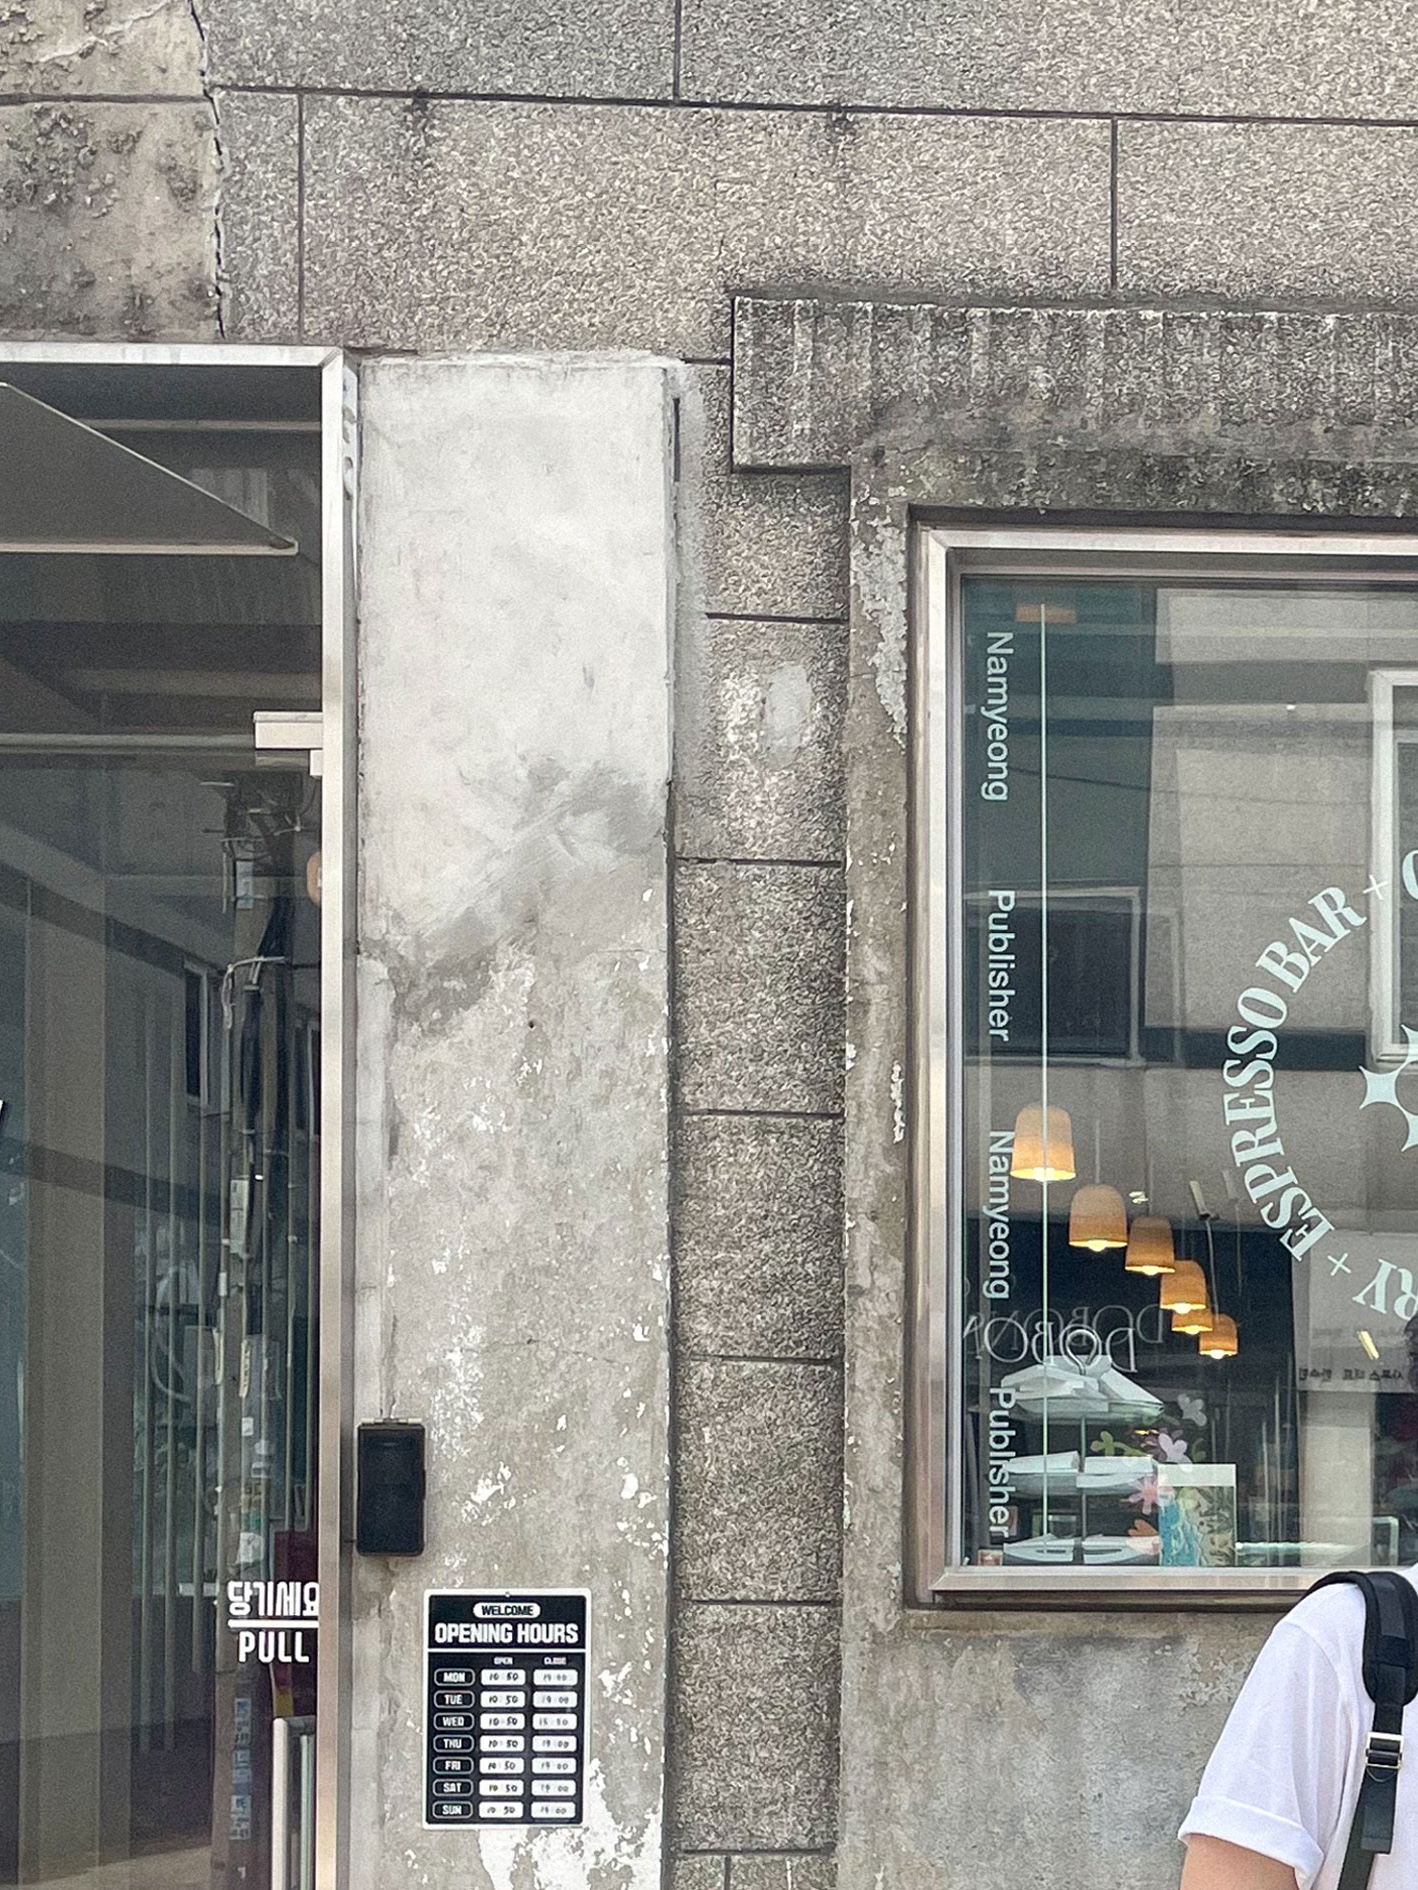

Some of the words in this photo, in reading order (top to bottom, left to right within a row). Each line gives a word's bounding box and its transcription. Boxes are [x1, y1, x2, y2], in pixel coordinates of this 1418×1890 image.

[980, 631, 1014, 801] Namyeong
[1254, 885, 1368, 993] BAR
[988, 890, 1016, 1042] Publisher
[1221, 986, 1335, 1262] ESPRESSO
[982, 1130, 1016, 1300] Namyeong
[989, 1387, 1016, 1539] Publisher
[227, 1581, 319, 1616] 당기세요
[481, 1605, 534, 1616] WELCOME
[434, 1622, 513, 1644] OPENING
[517, 1622, 579, 1644] HOURS
[239, 1631, 309, 1663] PULL
[443, 1672, 466, 1683] MON
[444, 1694, 463, 1705] TUE
[442, 1716, 465, 1726] WED
[443, 1738, 462, 1749] THU
[445, 1760, 461, 1770] FRI
[443, 1783, 462, 1793] SAT
[442, 1805, 462, 1815] SUN
